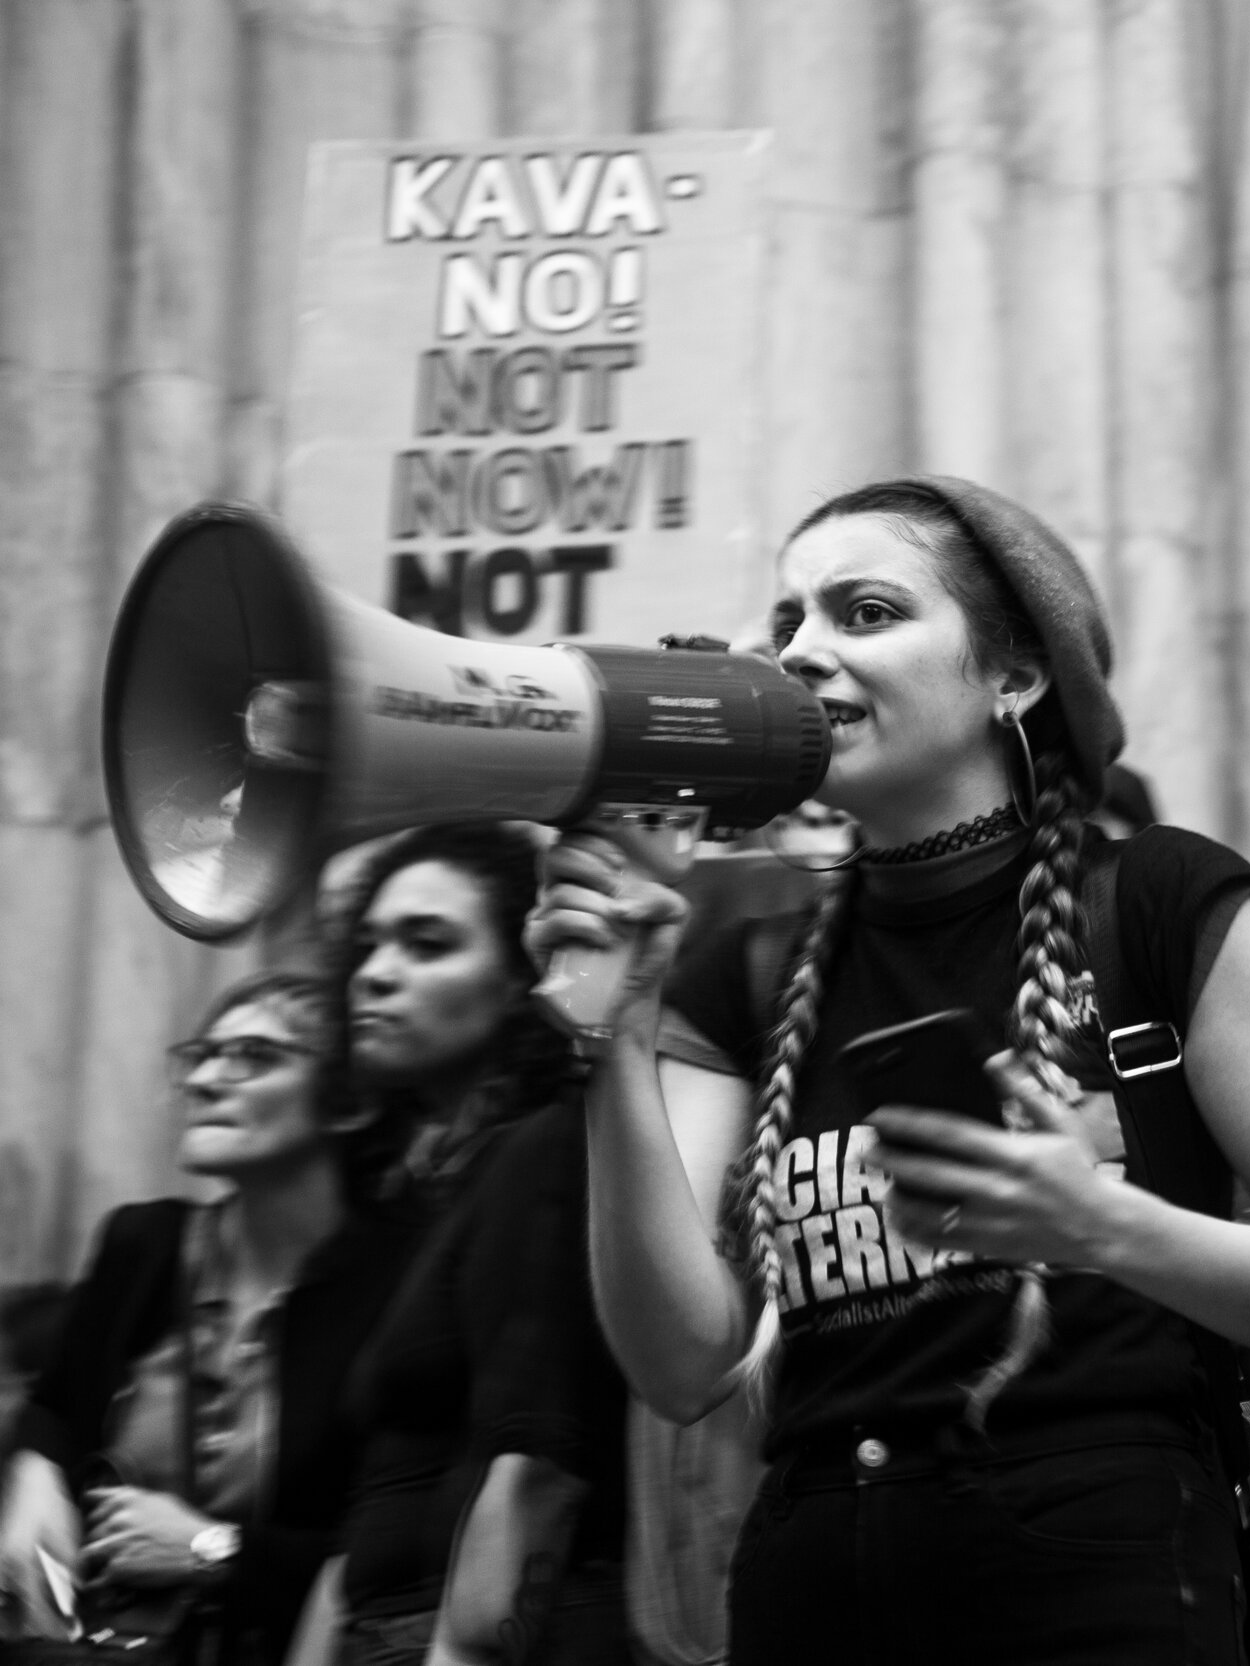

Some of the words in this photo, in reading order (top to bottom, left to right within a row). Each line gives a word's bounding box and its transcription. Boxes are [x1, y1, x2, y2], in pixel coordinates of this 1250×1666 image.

[386, 151, 702, 243] KAVA-
[438, 245, 644, 339] NO!
[416, 342, 642, 437] NOT
[393, 439, 690, 541] NOW!
[388, 544, 614, 638] NOT
